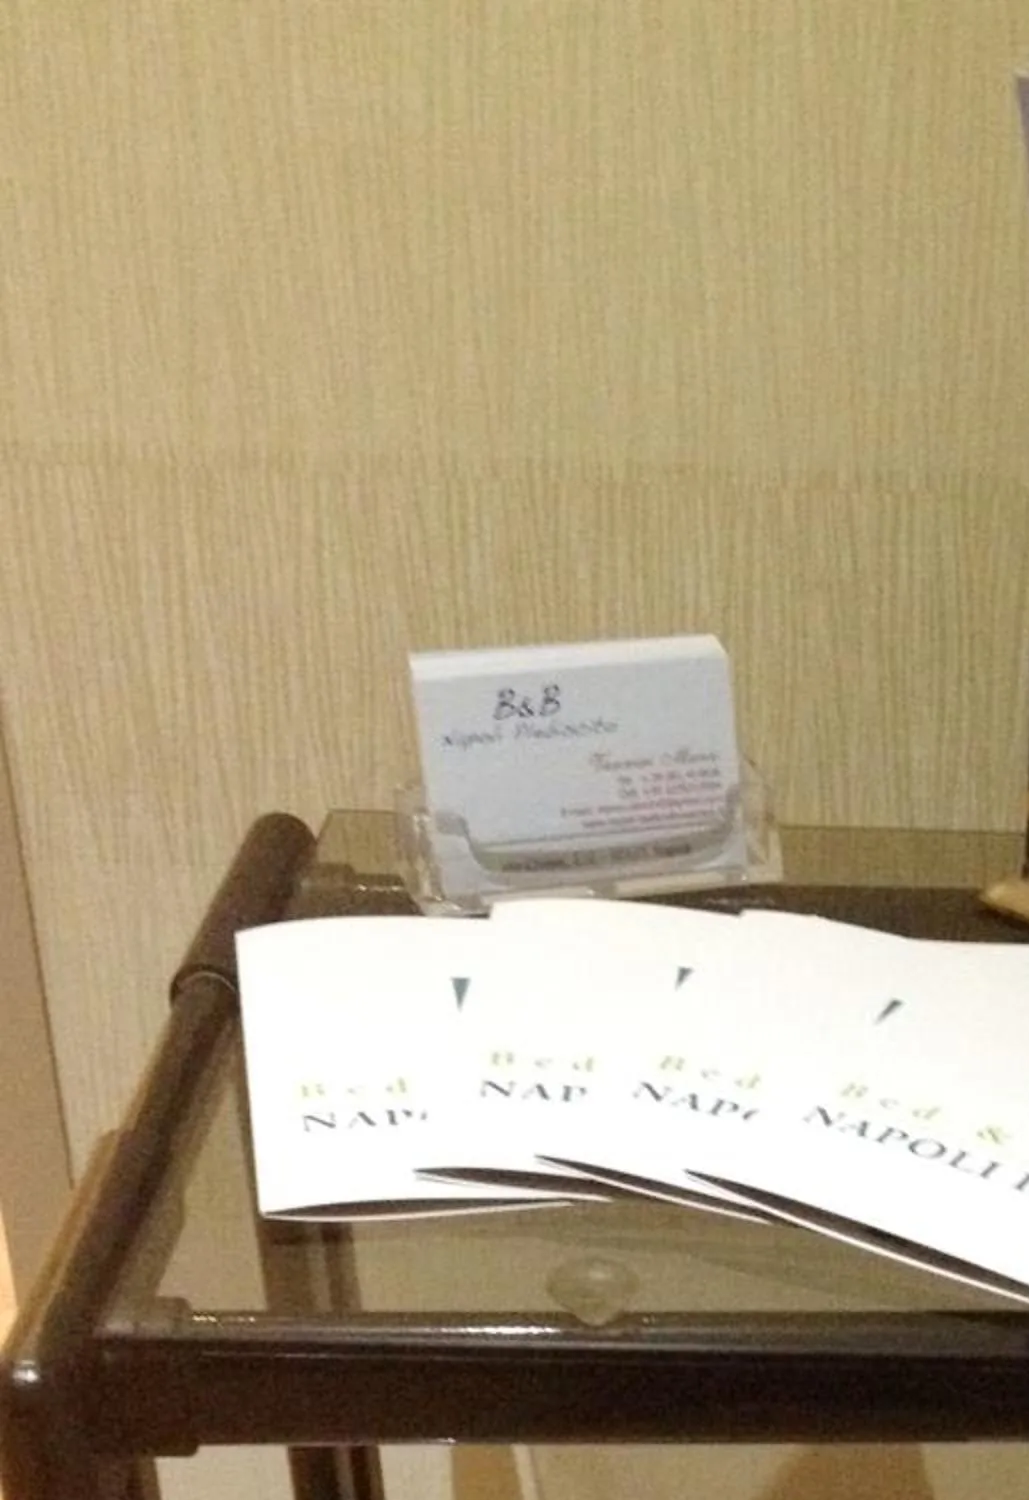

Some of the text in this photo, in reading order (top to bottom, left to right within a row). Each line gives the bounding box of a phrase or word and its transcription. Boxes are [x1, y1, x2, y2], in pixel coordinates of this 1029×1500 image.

[493, 684, 561, 721] B&B
[302, 1108, 428, 1132] NAP
[803, 1104, 1000, 1181] NAPOLI
